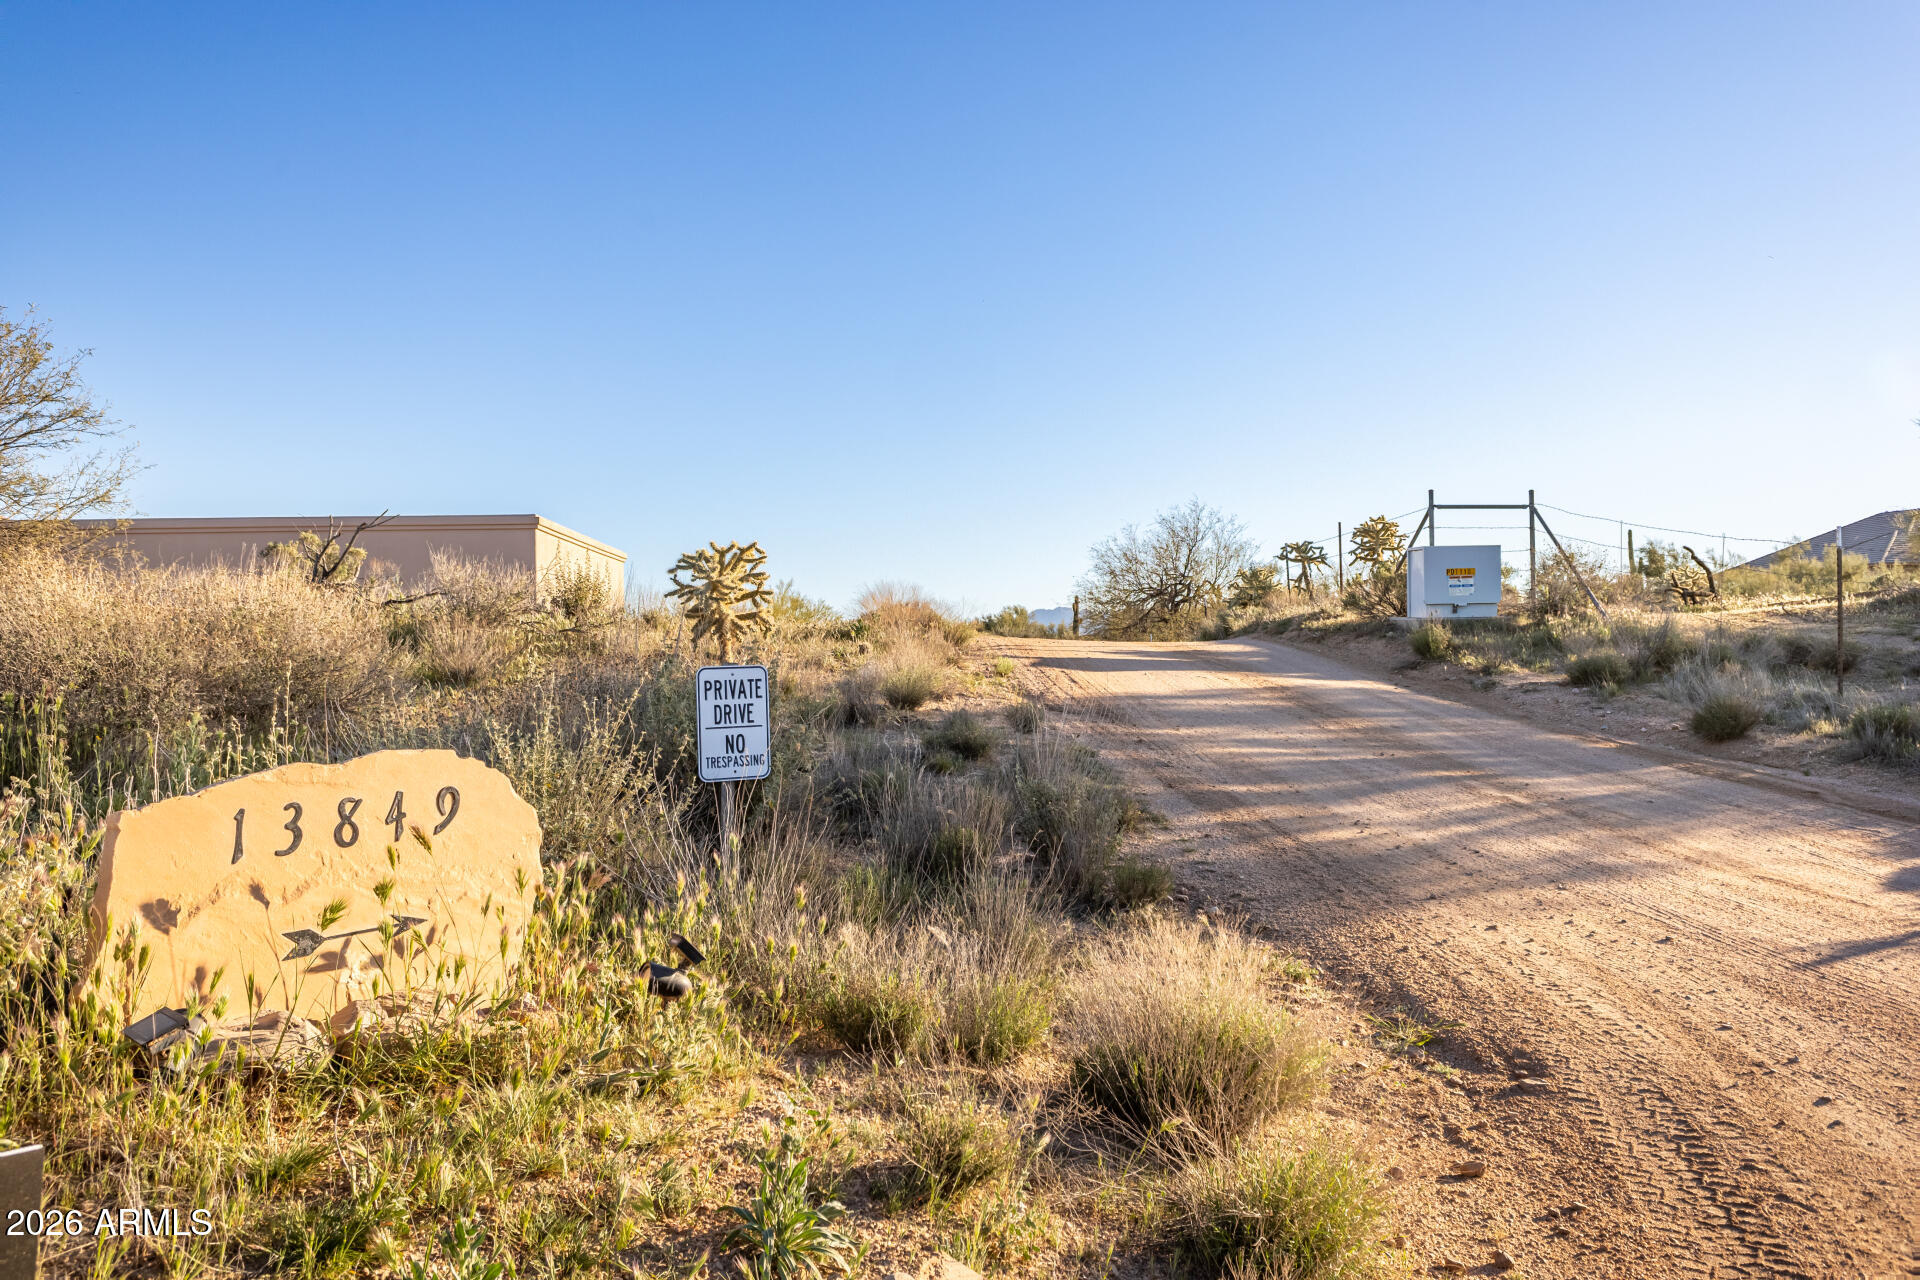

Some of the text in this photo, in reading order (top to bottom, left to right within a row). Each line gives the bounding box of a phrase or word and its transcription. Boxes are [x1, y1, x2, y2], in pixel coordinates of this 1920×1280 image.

[704, 679, 763, 701] PRIVATE
[713, 703, 755, 725] DRIVE
[725, 733, 746, 755] NO
[705, 753, 765, 769] TRESPASSING
[231, 785, 461, 865] 13849
